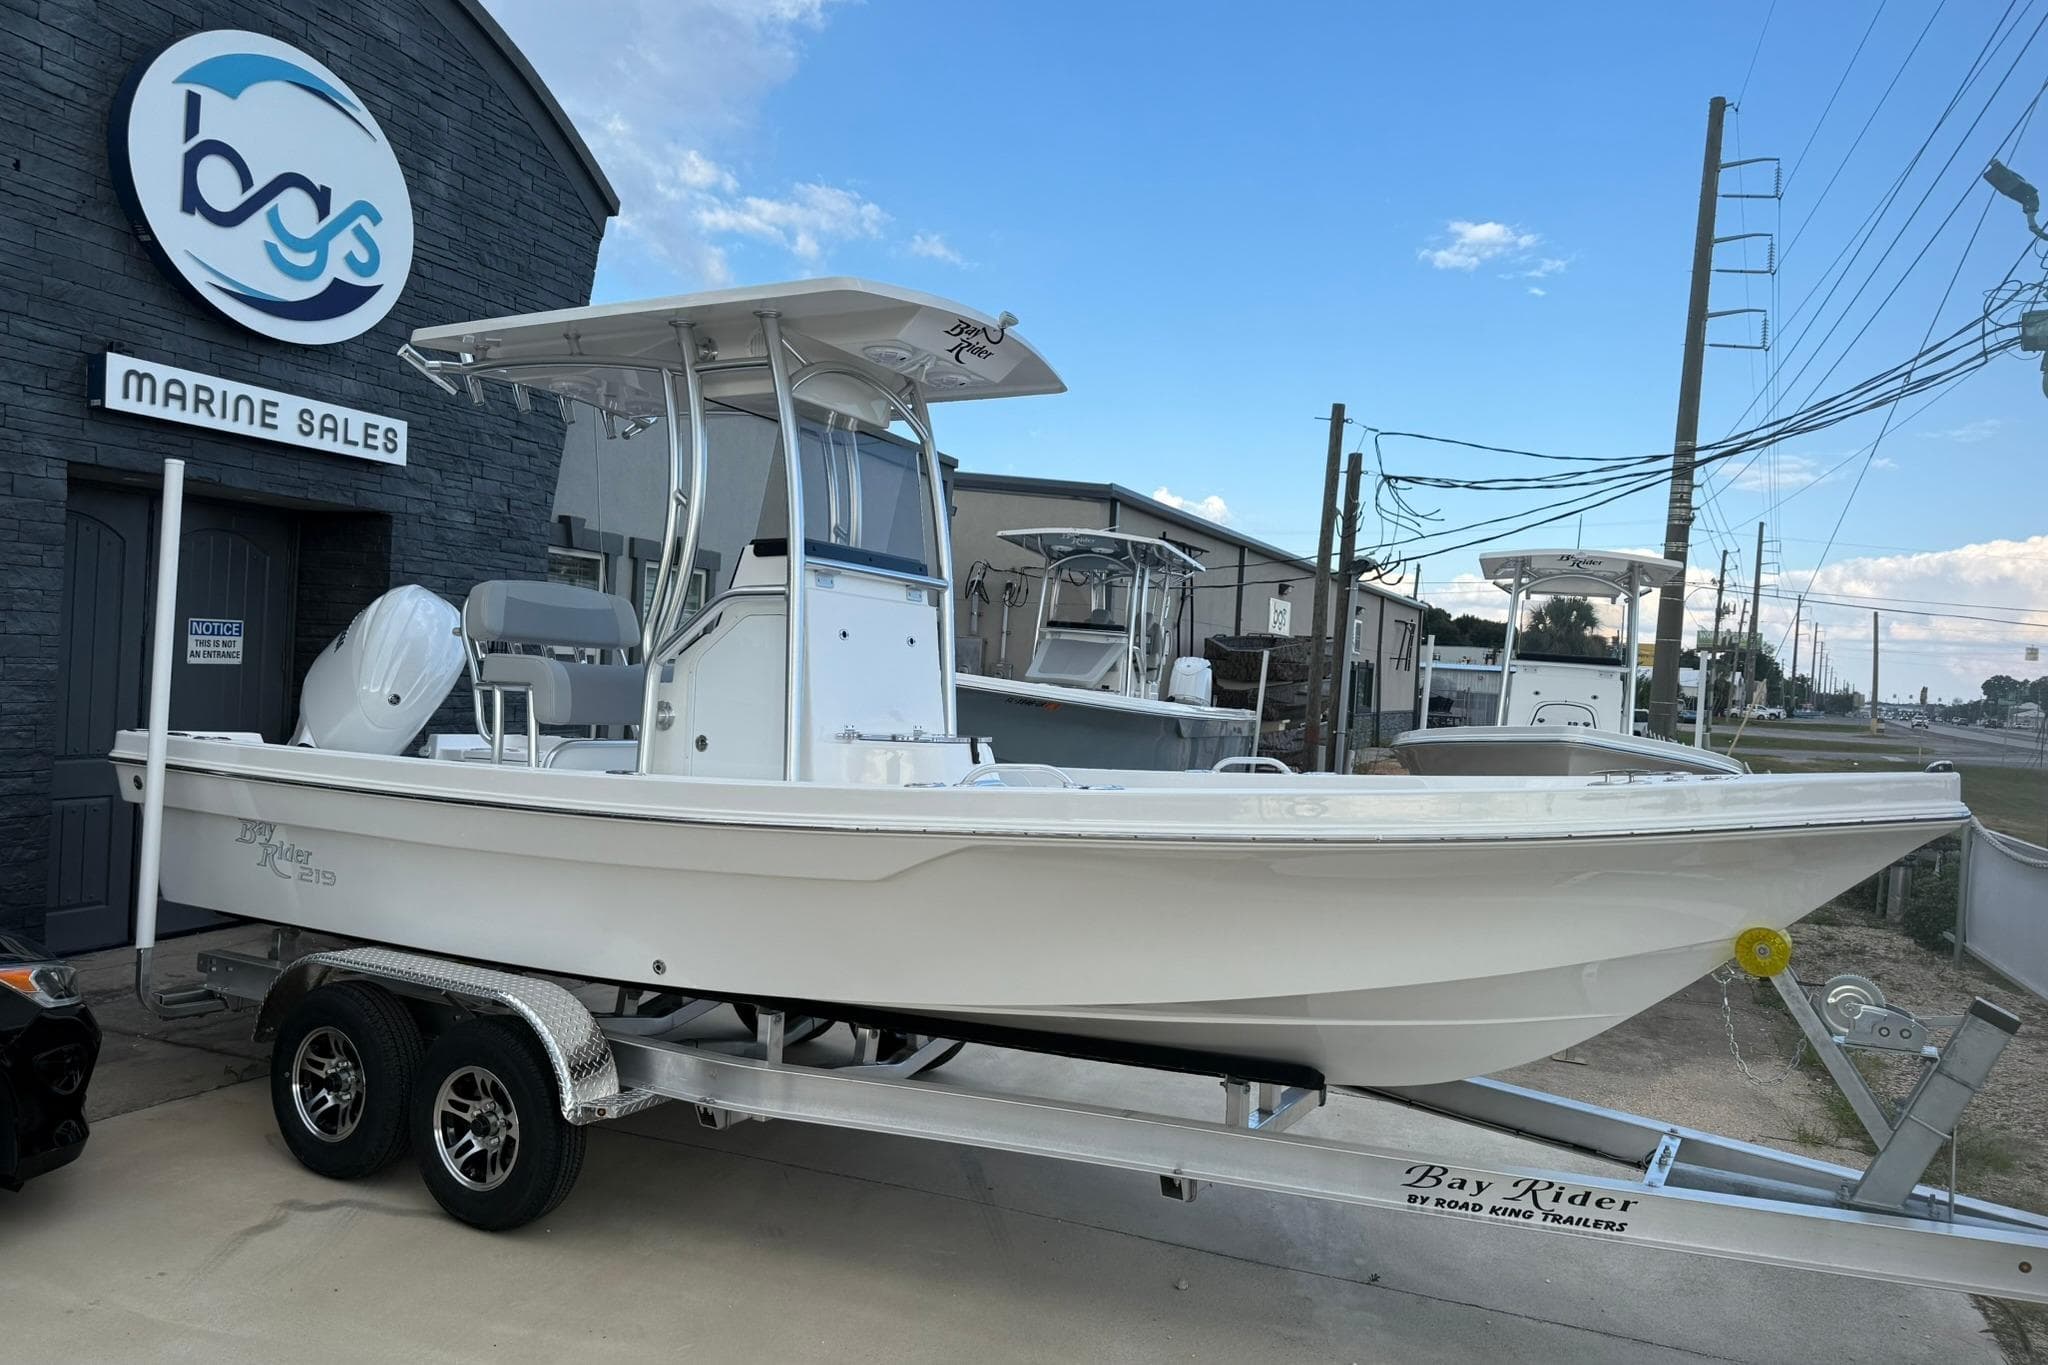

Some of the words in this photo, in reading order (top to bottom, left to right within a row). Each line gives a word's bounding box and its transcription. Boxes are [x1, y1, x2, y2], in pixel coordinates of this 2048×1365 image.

[943, 318, 982, 340] Bay
[945, 337, 995, 365] Rider
[122, 368, 279, 430] MARINE
[297, 408, 398, 454] SALES
[1569, 559, 1603, 570] Rider
[191, 621, 241, 636] NOTICE
[189, 650, 201, 658] AN
[202, 650, 241, 659] ENTRANCE
[195, 639, 212, 648] THIS
[213, 640, 221, 648] IS
[222, 640, 237, 648] NOT
[234, 817, 278, 844] Bay
[256, 840, 312, 879] Rider
[298, 865, 336, 887] 219
[1400, 1164, 1495, 1197] Bay
[1502, 1178, 1639, 1213] Rider
[1406, 1194, 1430, 1205] BY
[1434, 1197, 1484, 1213] ROAD
[1489, 1205, 1535, 1220] KING
[1541, 1212, 1629, 1233] TRAILERS
